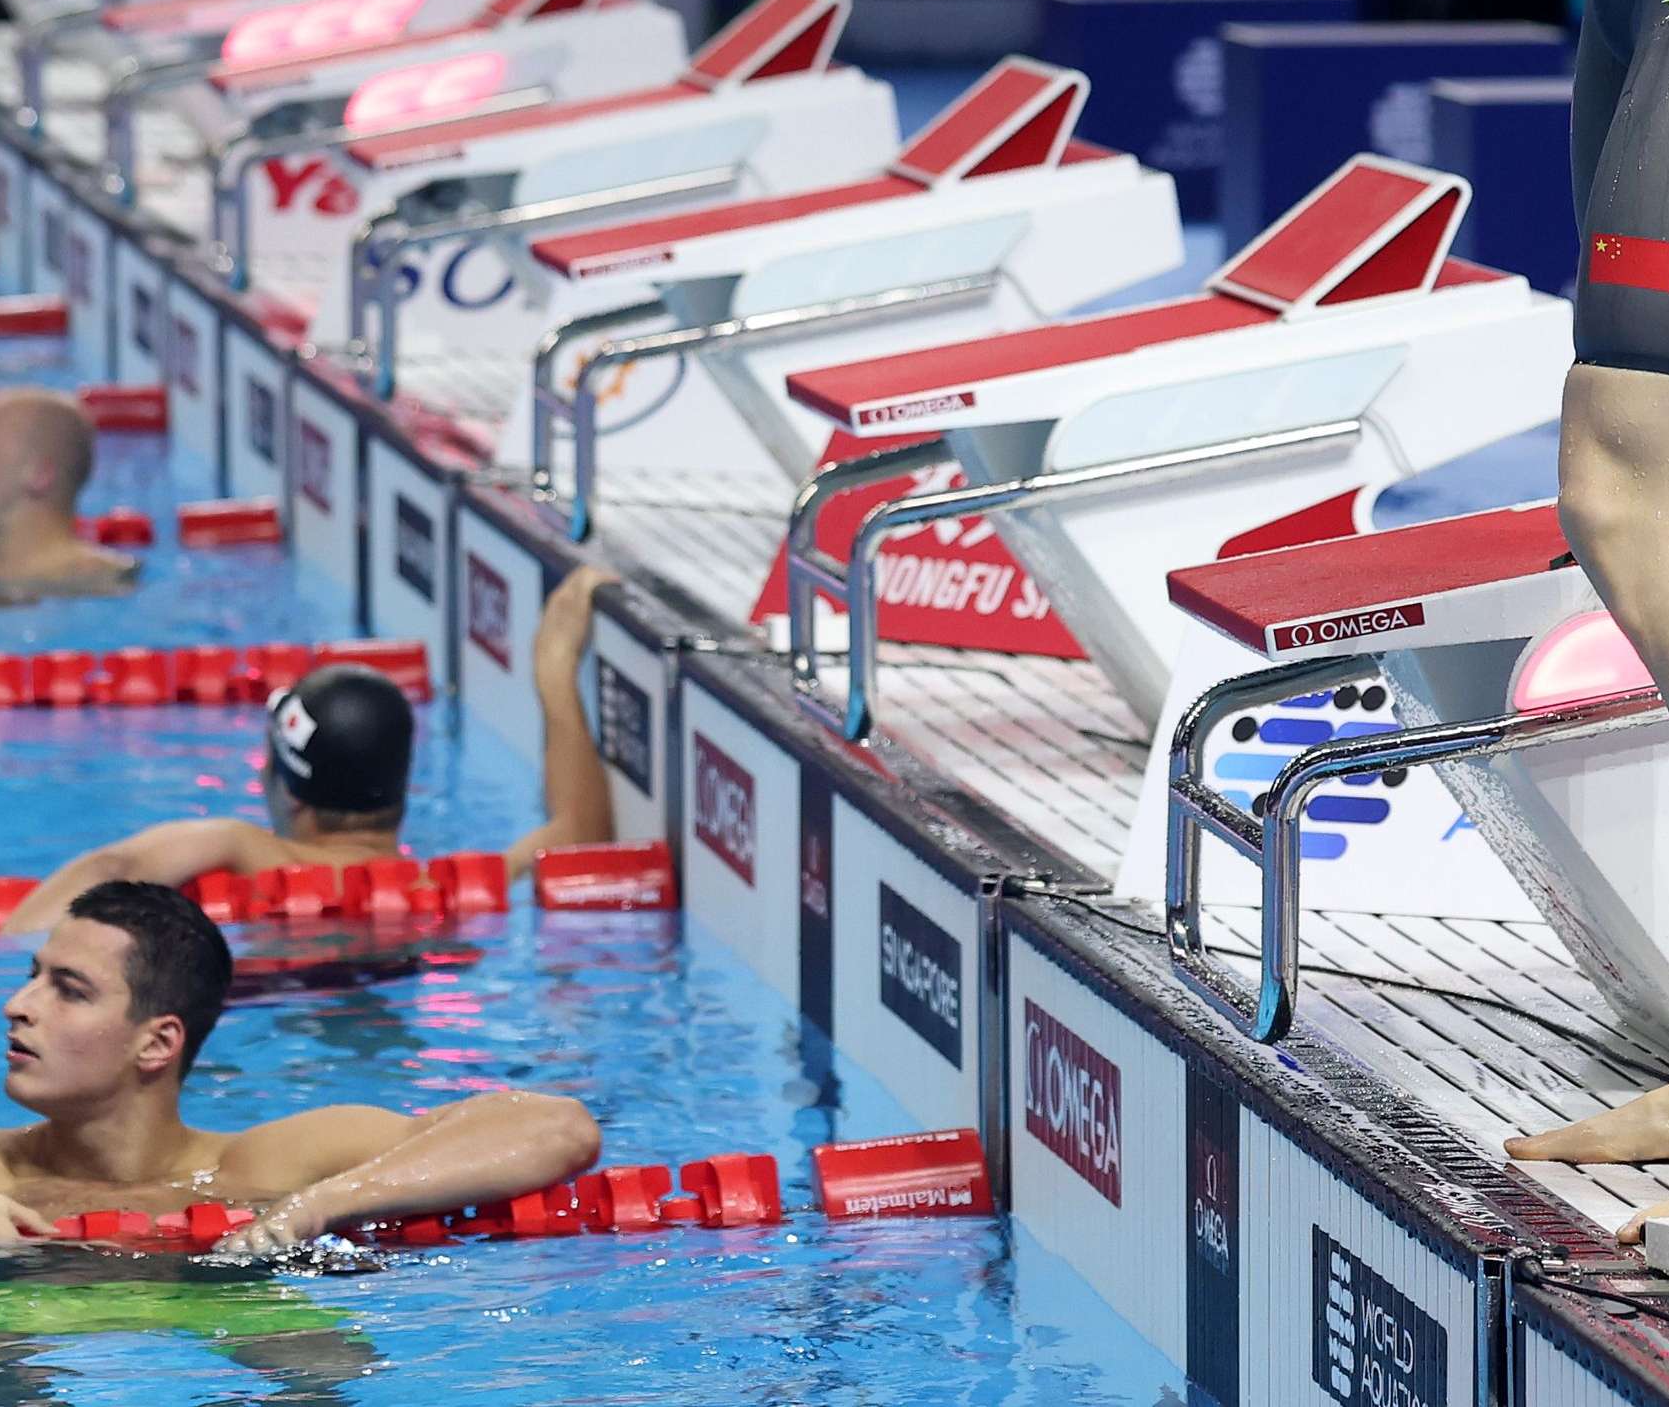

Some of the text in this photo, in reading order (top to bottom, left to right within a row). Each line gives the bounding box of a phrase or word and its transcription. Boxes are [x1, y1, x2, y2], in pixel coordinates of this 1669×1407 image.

[1319, 609, 1409, 641] OMEGA
[882, 925, 958, 1030] SINGAPORE
[1046, 1046, 1121, 1175] OMEGA
[844, 1188, 947, 1214] Malmsten
[1194, 1197, 1229, 1262] OMEGA
[1361, 1295, 1414, 1375] WORLD
